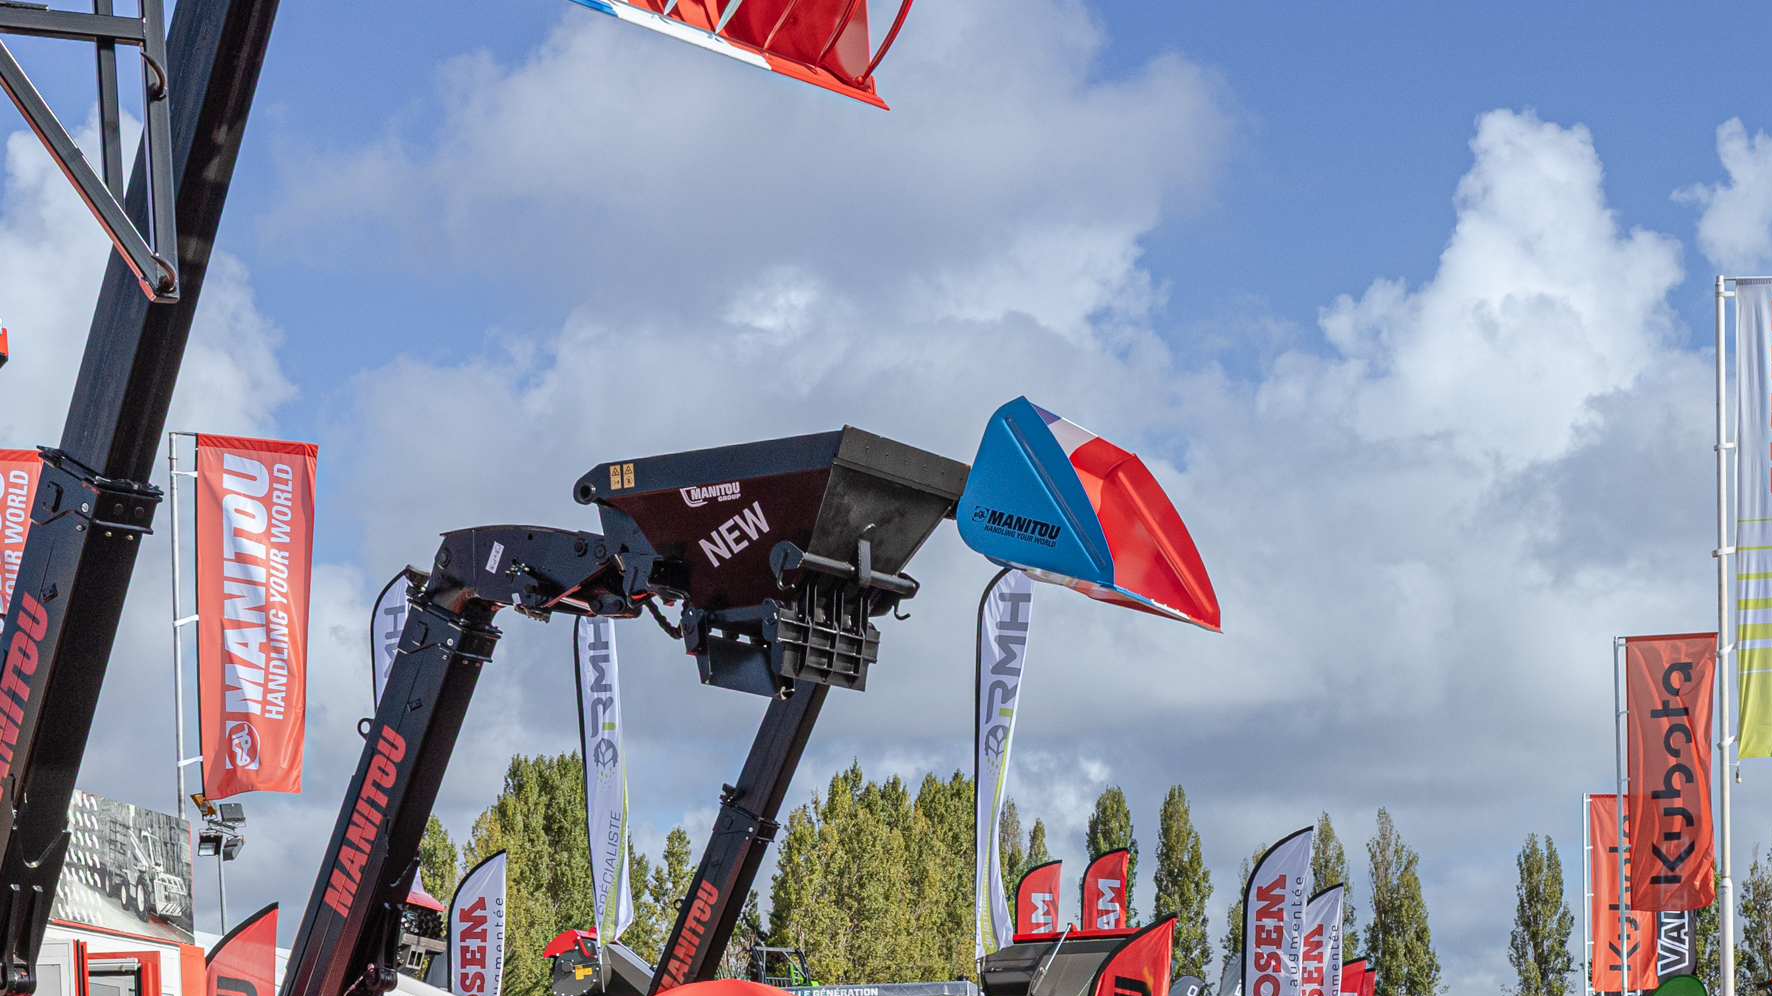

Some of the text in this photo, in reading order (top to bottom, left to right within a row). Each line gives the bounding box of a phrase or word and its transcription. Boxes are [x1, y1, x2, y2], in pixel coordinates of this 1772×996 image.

[4, 469, 29, 544] WORLD
[691, 482, 740, 500] MANITOU
[718, 493, 741, 502] GROUP
[987, 509, 1062, 540] MANITOU
[698, 500, 770, 568] NEW
[984, 524, 1057, 548] HANDLING YOUR WORLD
[223, 453, 270, 716] MANITOU
[265, 463, 293, 720] HANDLING YOUR WORLD
[1650, 661, 1695, 885] Kubota
[323, 724, 406, 918] MANITOU
[1289, 876, 1304, 988] augmentée
